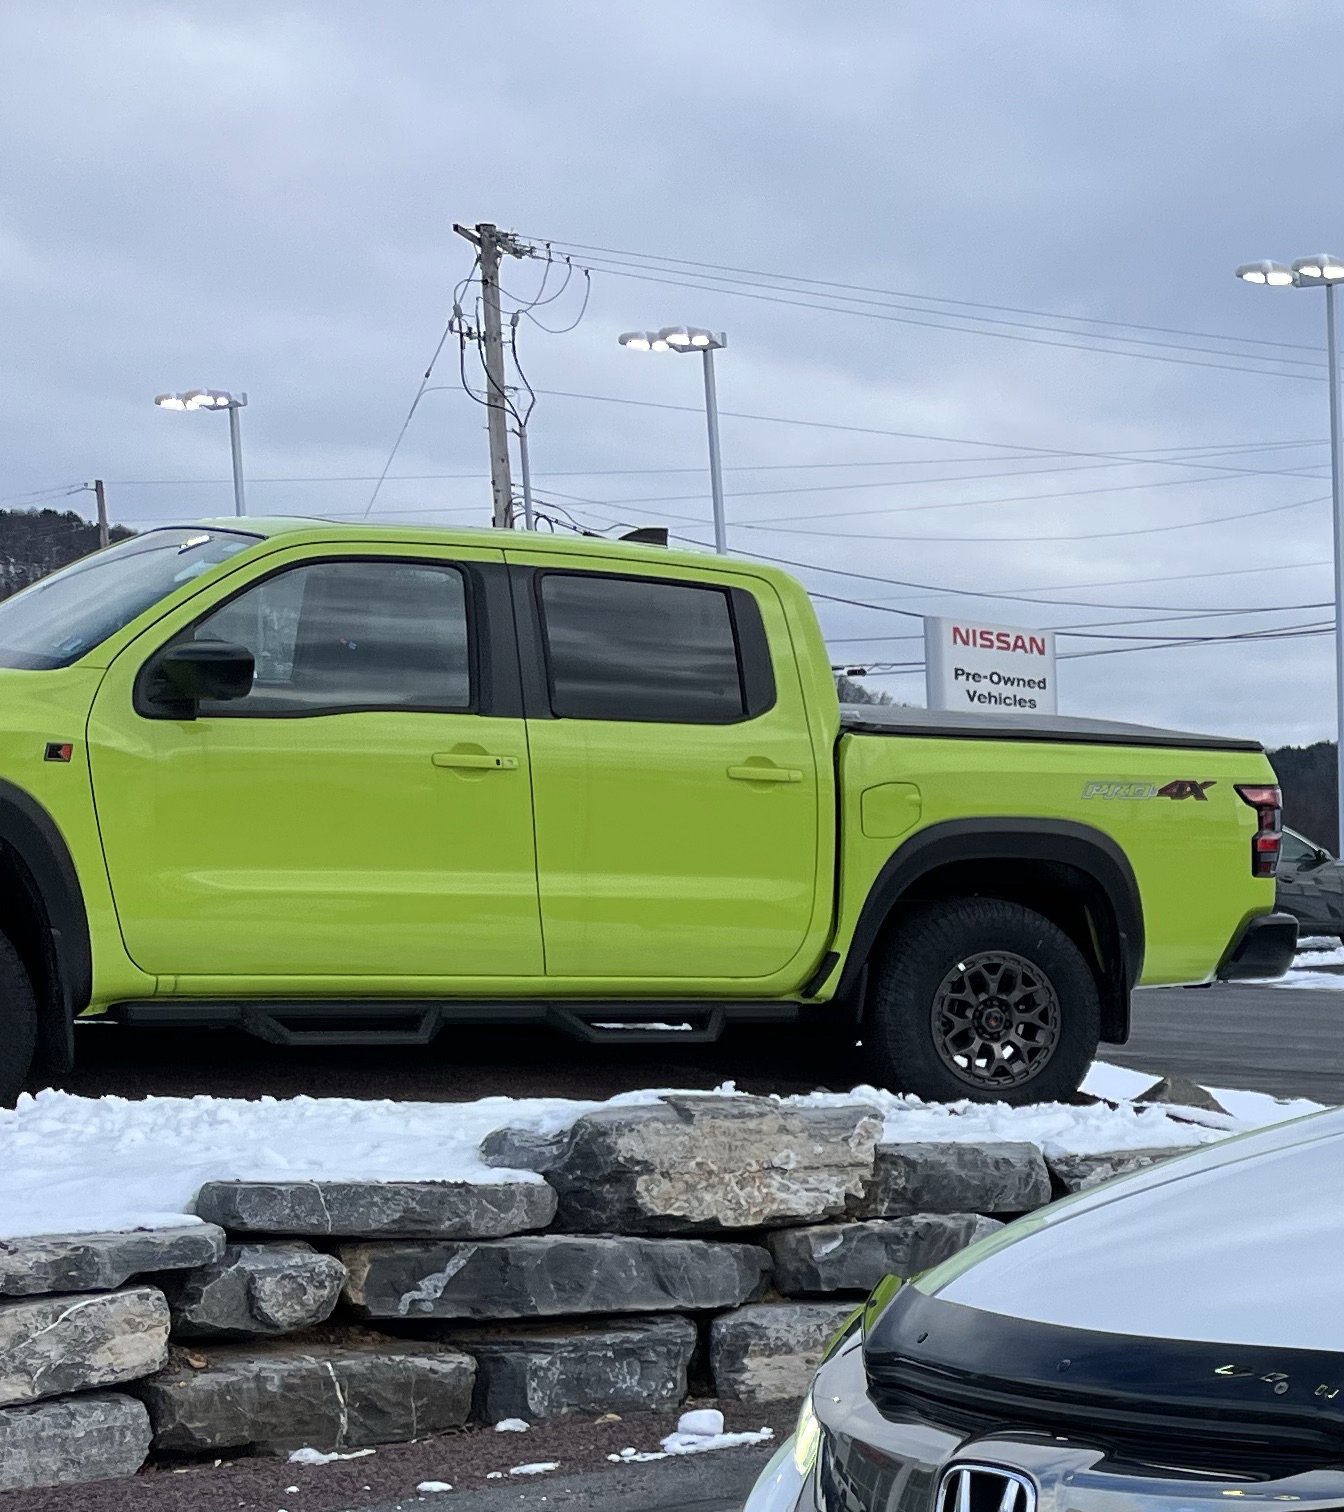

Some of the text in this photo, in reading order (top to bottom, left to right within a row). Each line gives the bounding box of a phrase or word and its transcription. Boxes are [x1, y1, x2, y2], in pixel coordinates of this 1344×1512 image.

[952, 626, 1046, 657] NISSAN
[954, 667, 1047, 690] Pre-Owned
[966, 689, 1037, 709] Vehicles
